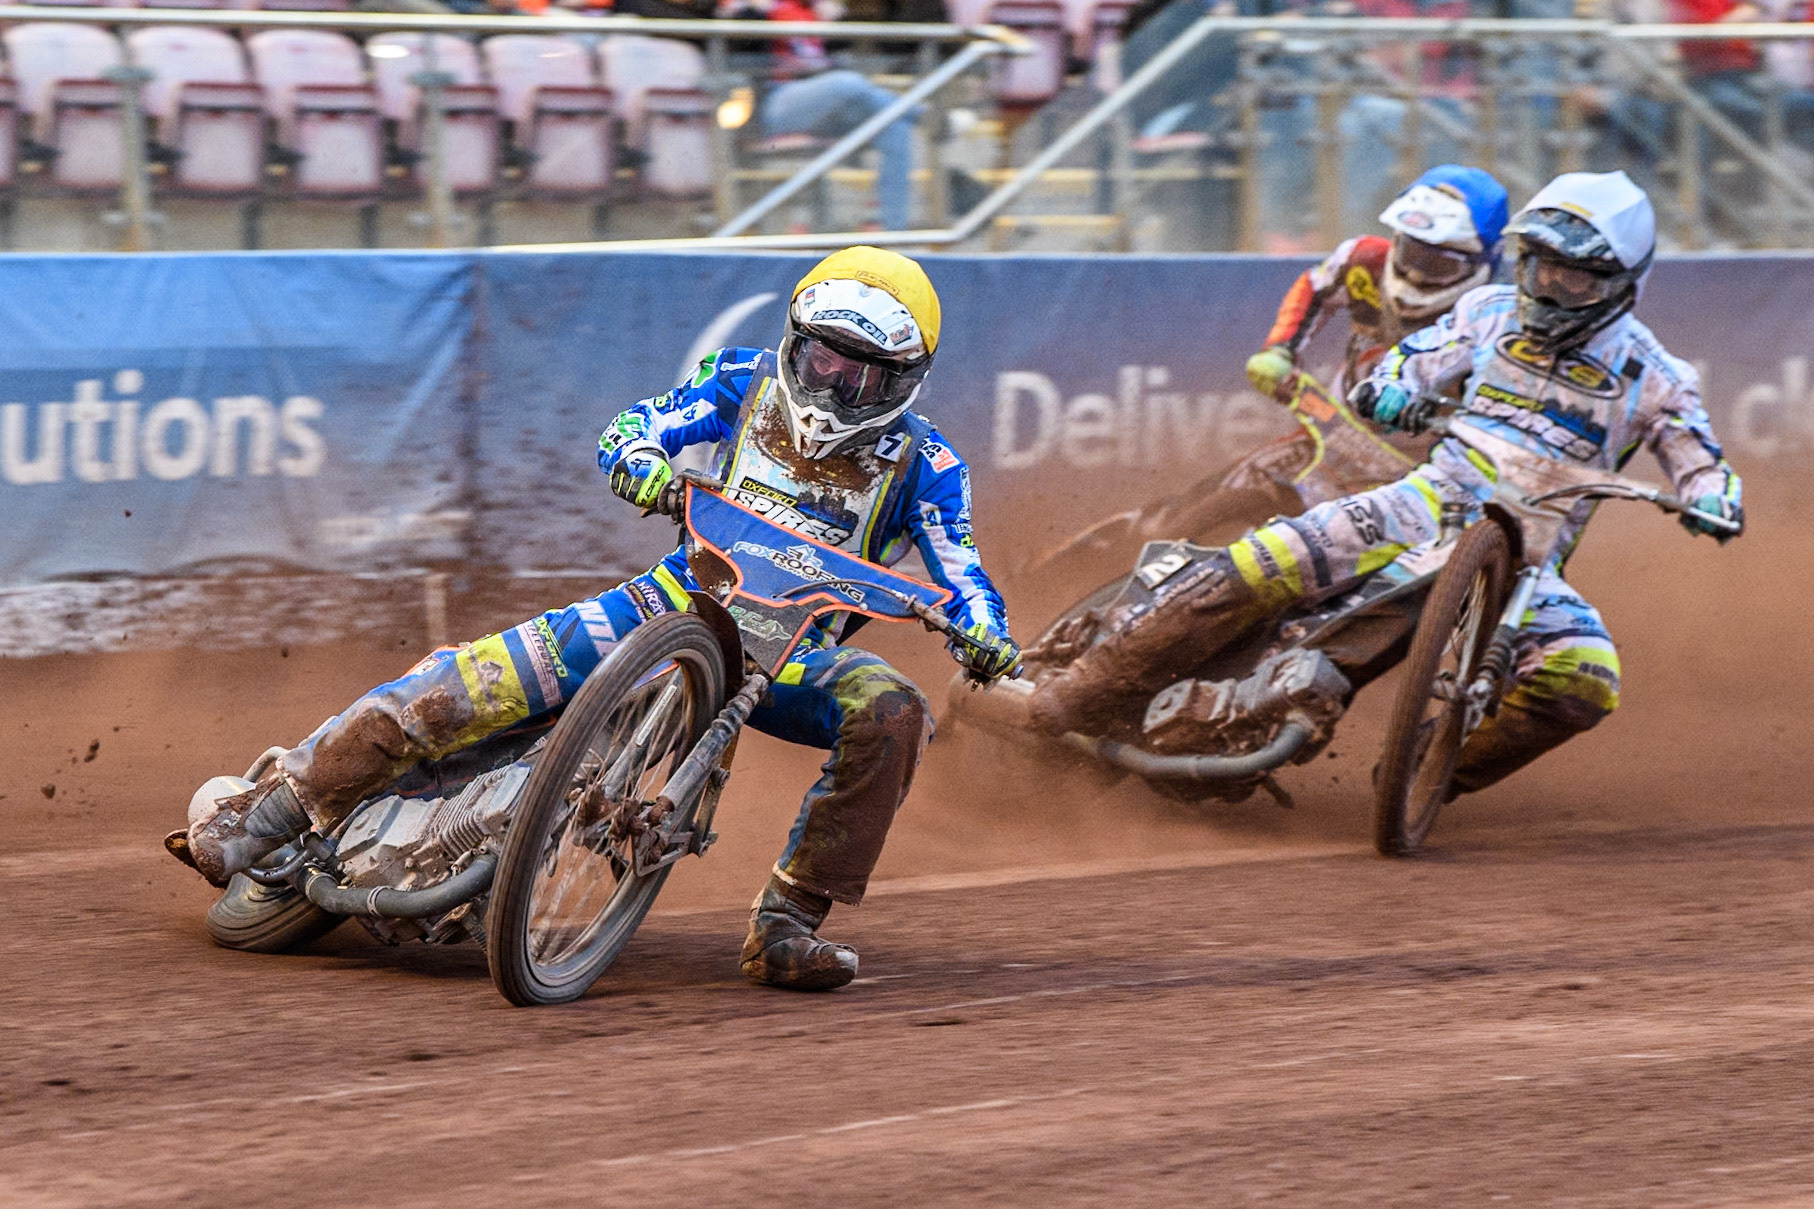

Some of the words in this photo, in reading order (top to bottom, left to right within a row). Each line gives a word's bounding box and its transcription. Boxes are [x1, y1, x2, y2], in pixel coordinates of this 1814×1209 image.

[812, 310, 862, 323] ROCK
[861, 322, 888, 344] OIL
[1, 369, 324, 485] utions
[993, 365, 1288, 468] Delive
[881, 436, 902, 457] 7
[736, 490, 850, 546] SPIRES
[742, 479, 798, 508] OXFORD
[532, 616, 569, 678] OXFORD
